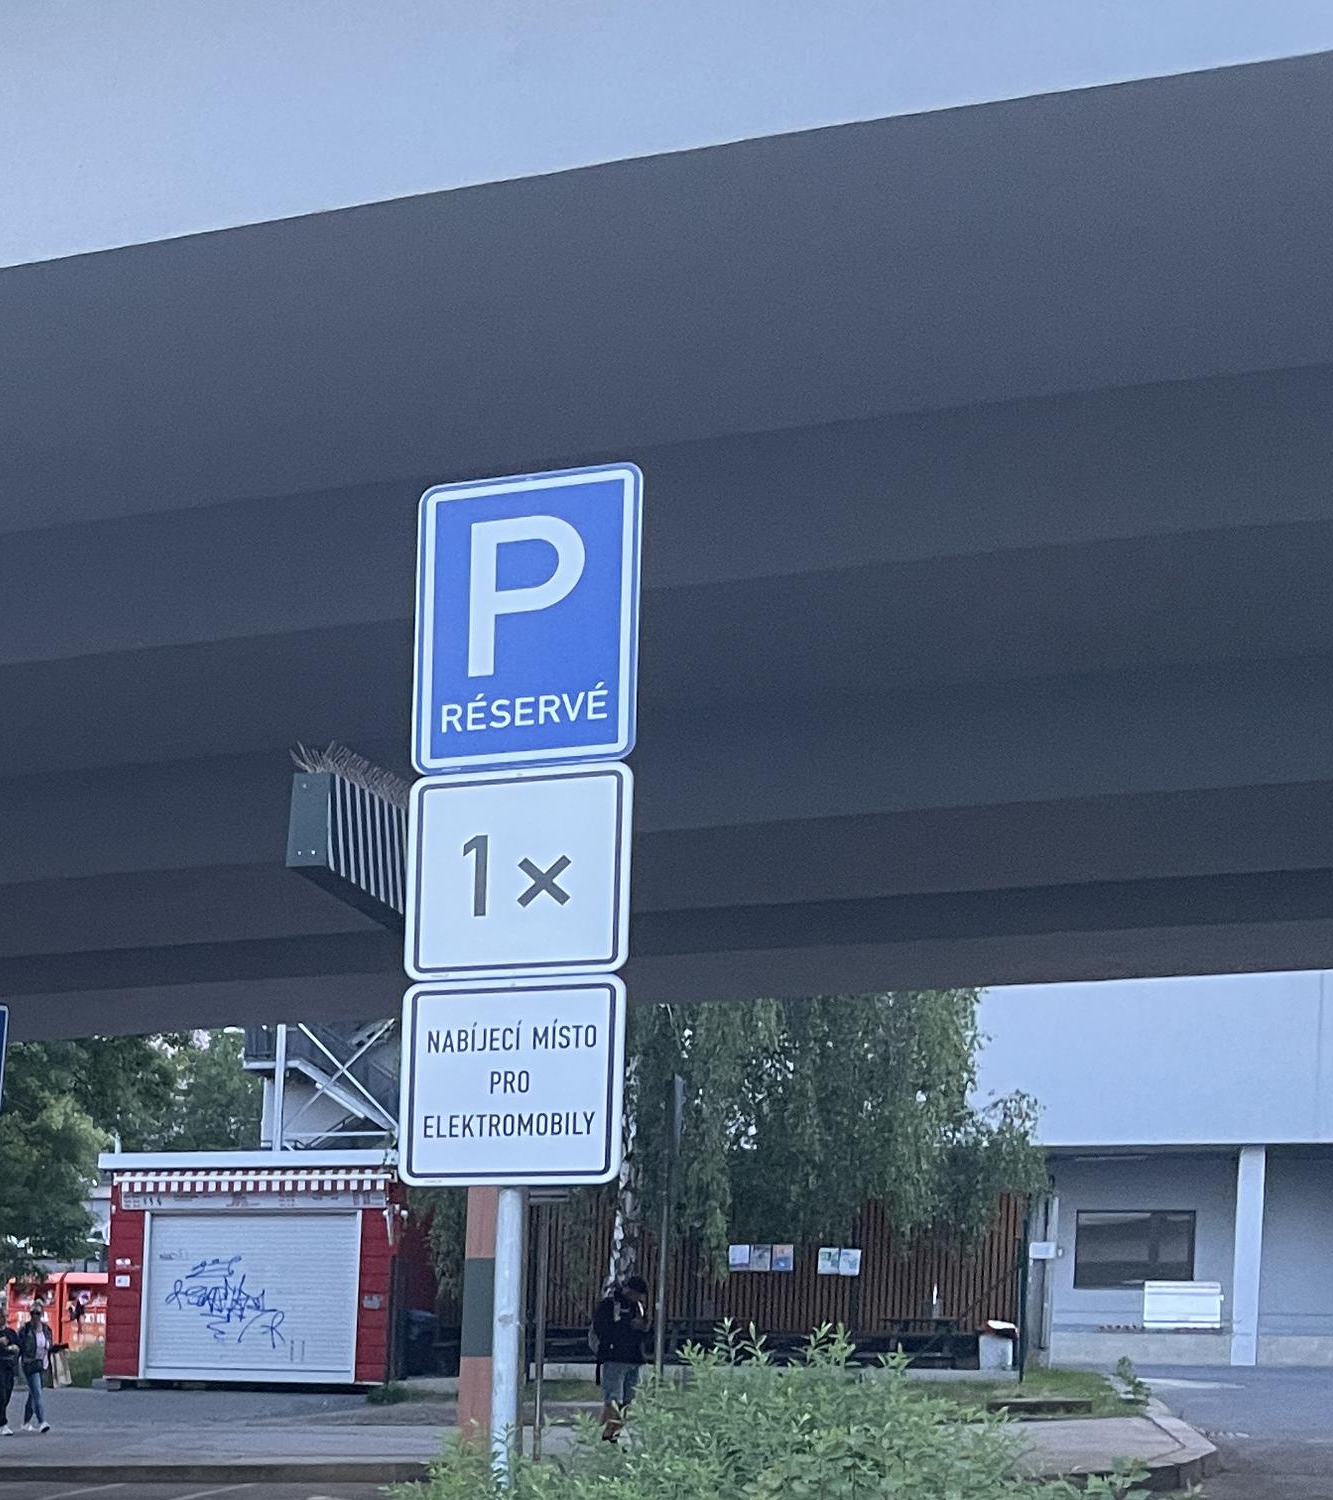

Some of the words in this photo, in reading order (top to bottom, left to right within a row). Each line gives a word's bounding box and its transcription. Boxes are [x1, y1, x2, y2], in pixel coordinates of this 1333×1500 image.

[468, 515, 586, 678] P
[440, 681, 609, 734] RÉSERVÉ
[426, 1019, 523, 1054] NABÍJECÍ
[532, 1017, 598, 1051] MÍSTO
[489, 1069, 531, 1095] PRO
[422, 1110, 597, 1139] ELEKTROMOBILY
